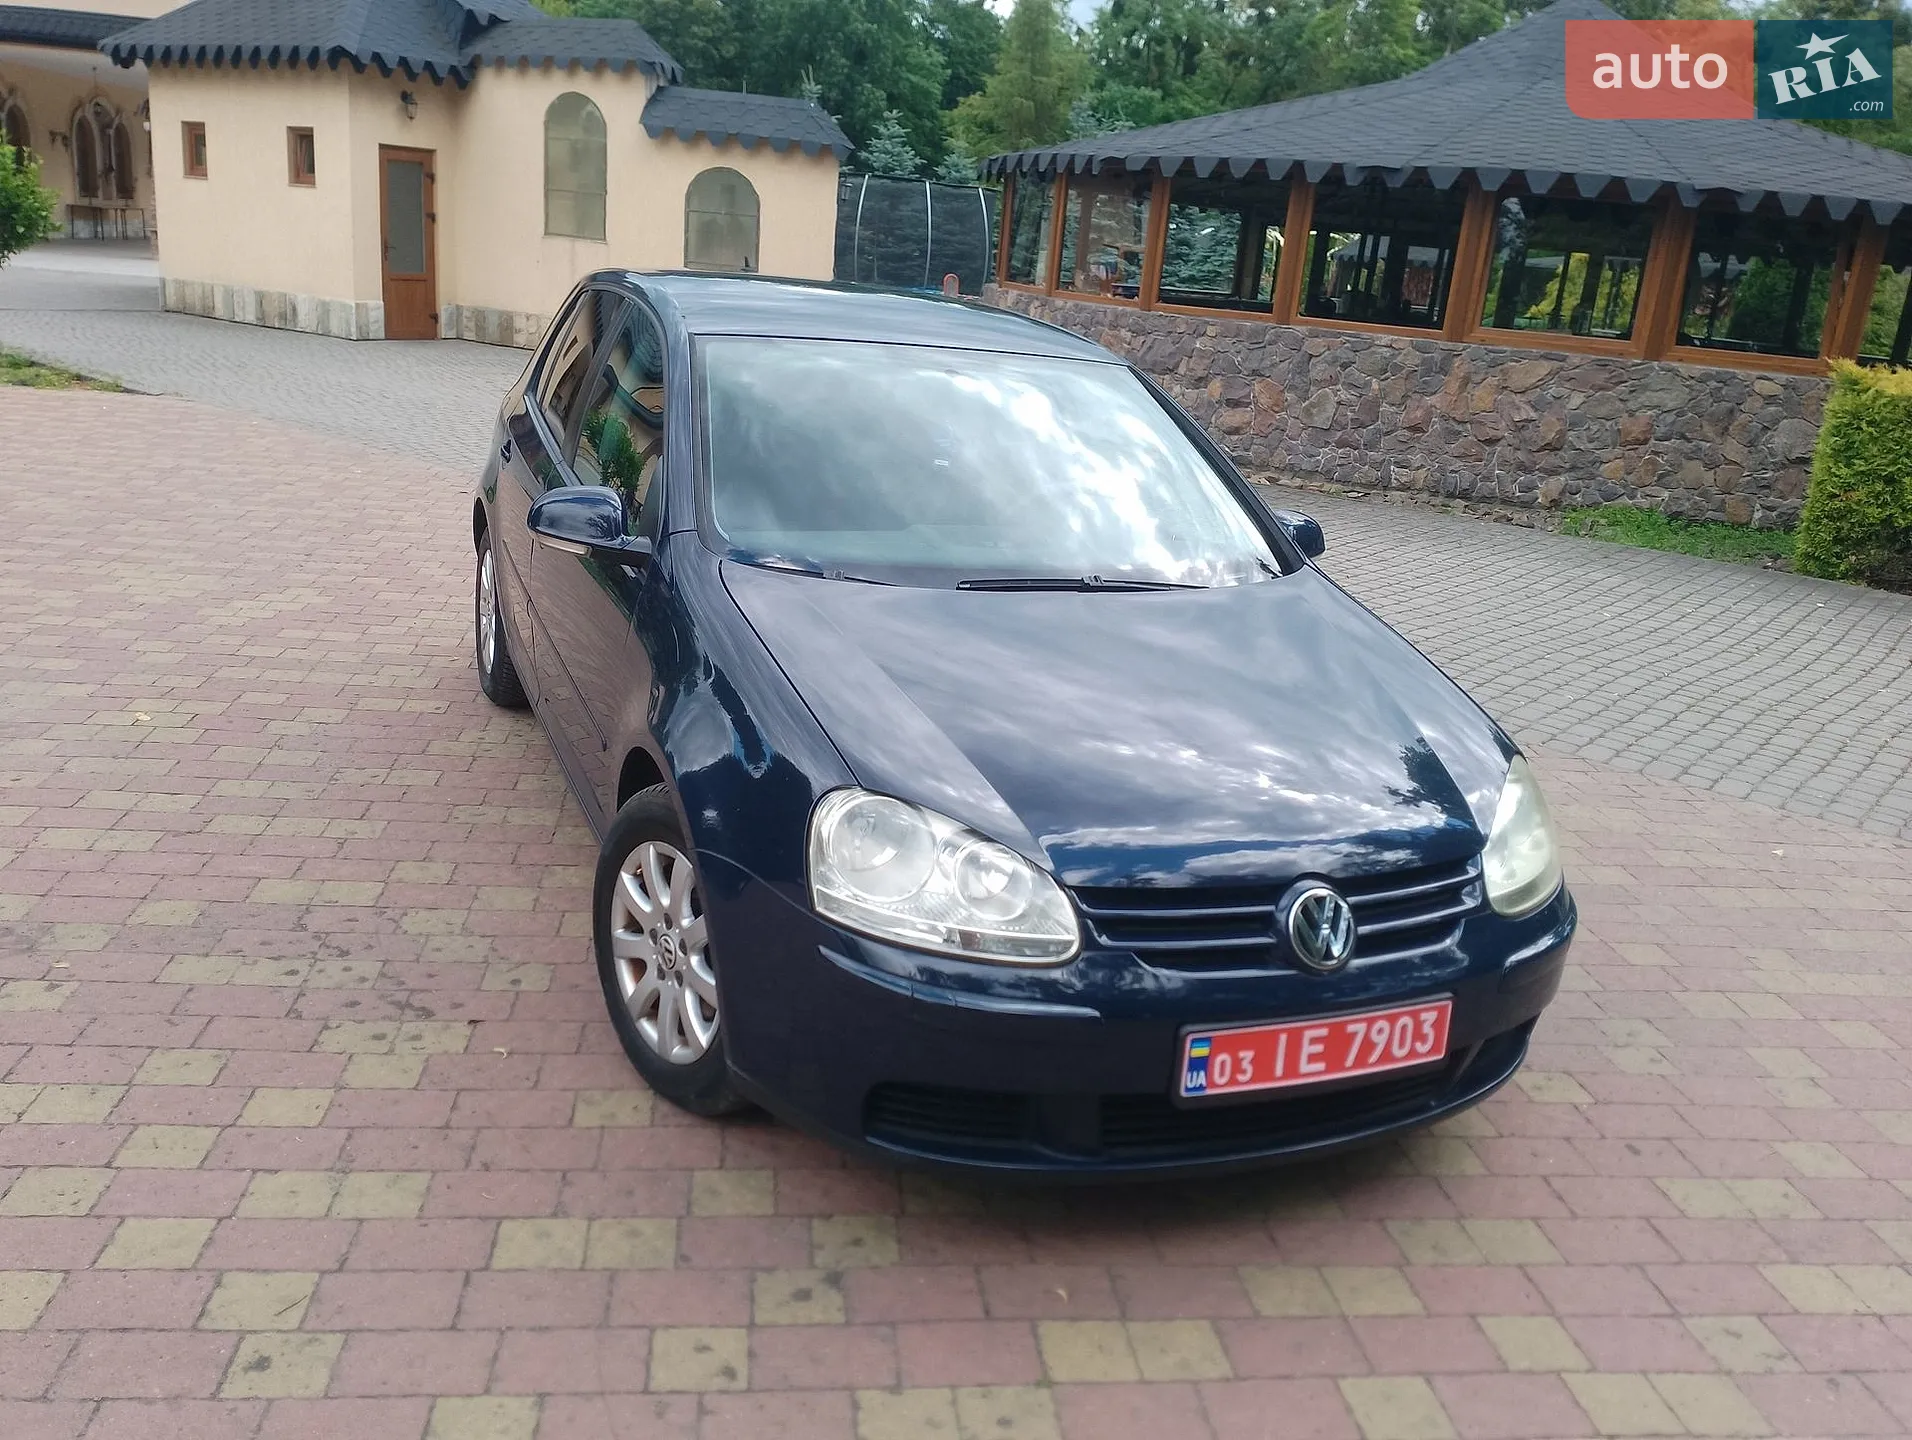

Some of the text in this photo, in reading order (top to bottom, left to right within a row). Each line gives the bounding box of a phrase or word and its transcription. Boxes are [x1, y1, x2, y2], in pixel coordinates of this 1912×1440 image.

[1213, 1049, 1255, 1085] 03
[1345, 1011, 1439, 1067] 7903
[1186, 1070, 1207, 1089] UA
